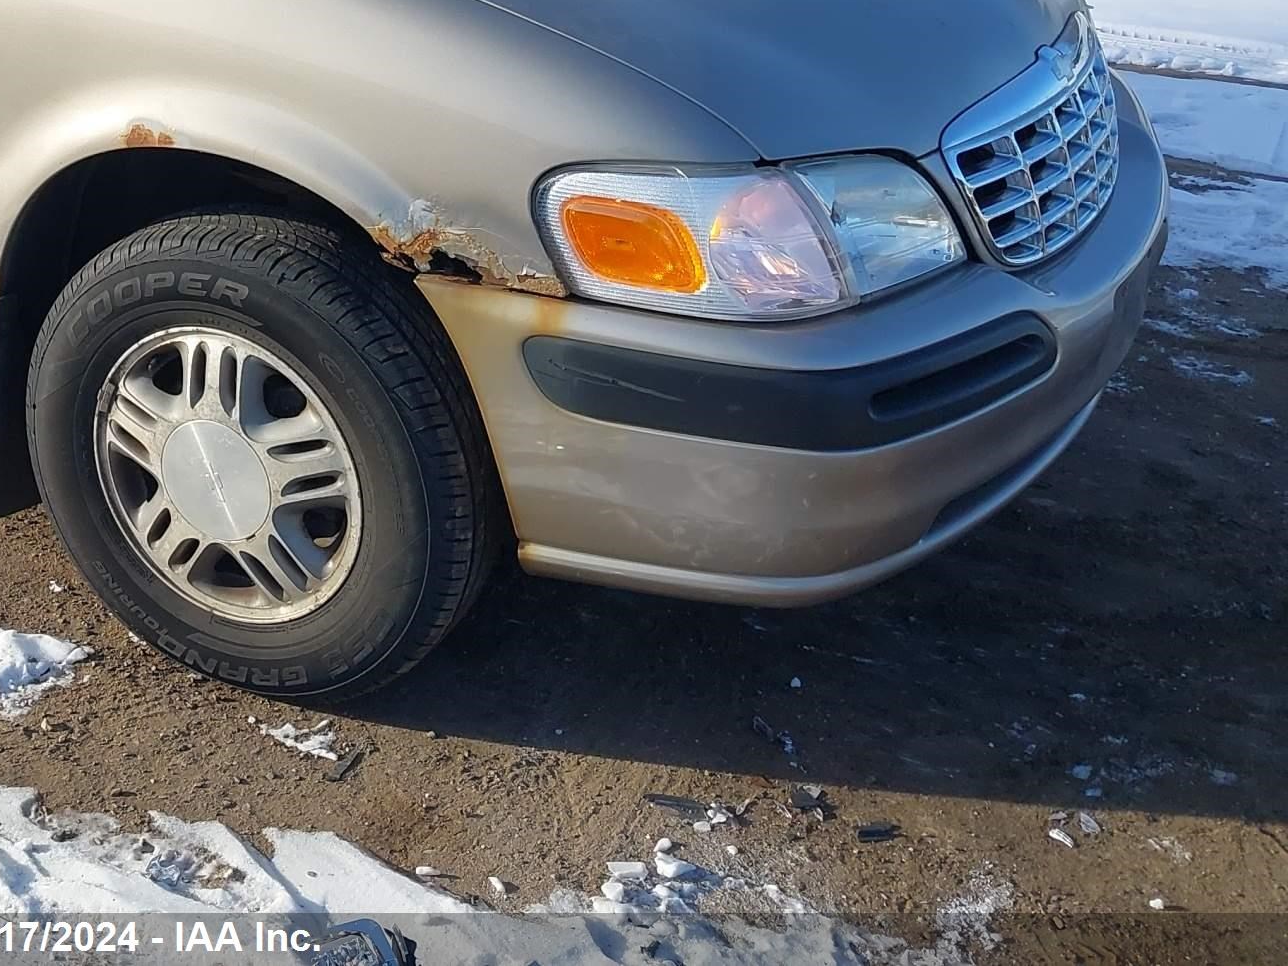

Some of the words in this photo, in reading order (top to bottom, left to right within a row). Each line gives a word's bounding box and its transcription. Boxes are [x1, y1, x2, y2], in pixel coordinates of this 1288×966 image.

[66, 270, 249, 348] COOPER
[91, 560, 169, 640] TOURING
[157, 634, 308, 686] GRAND
